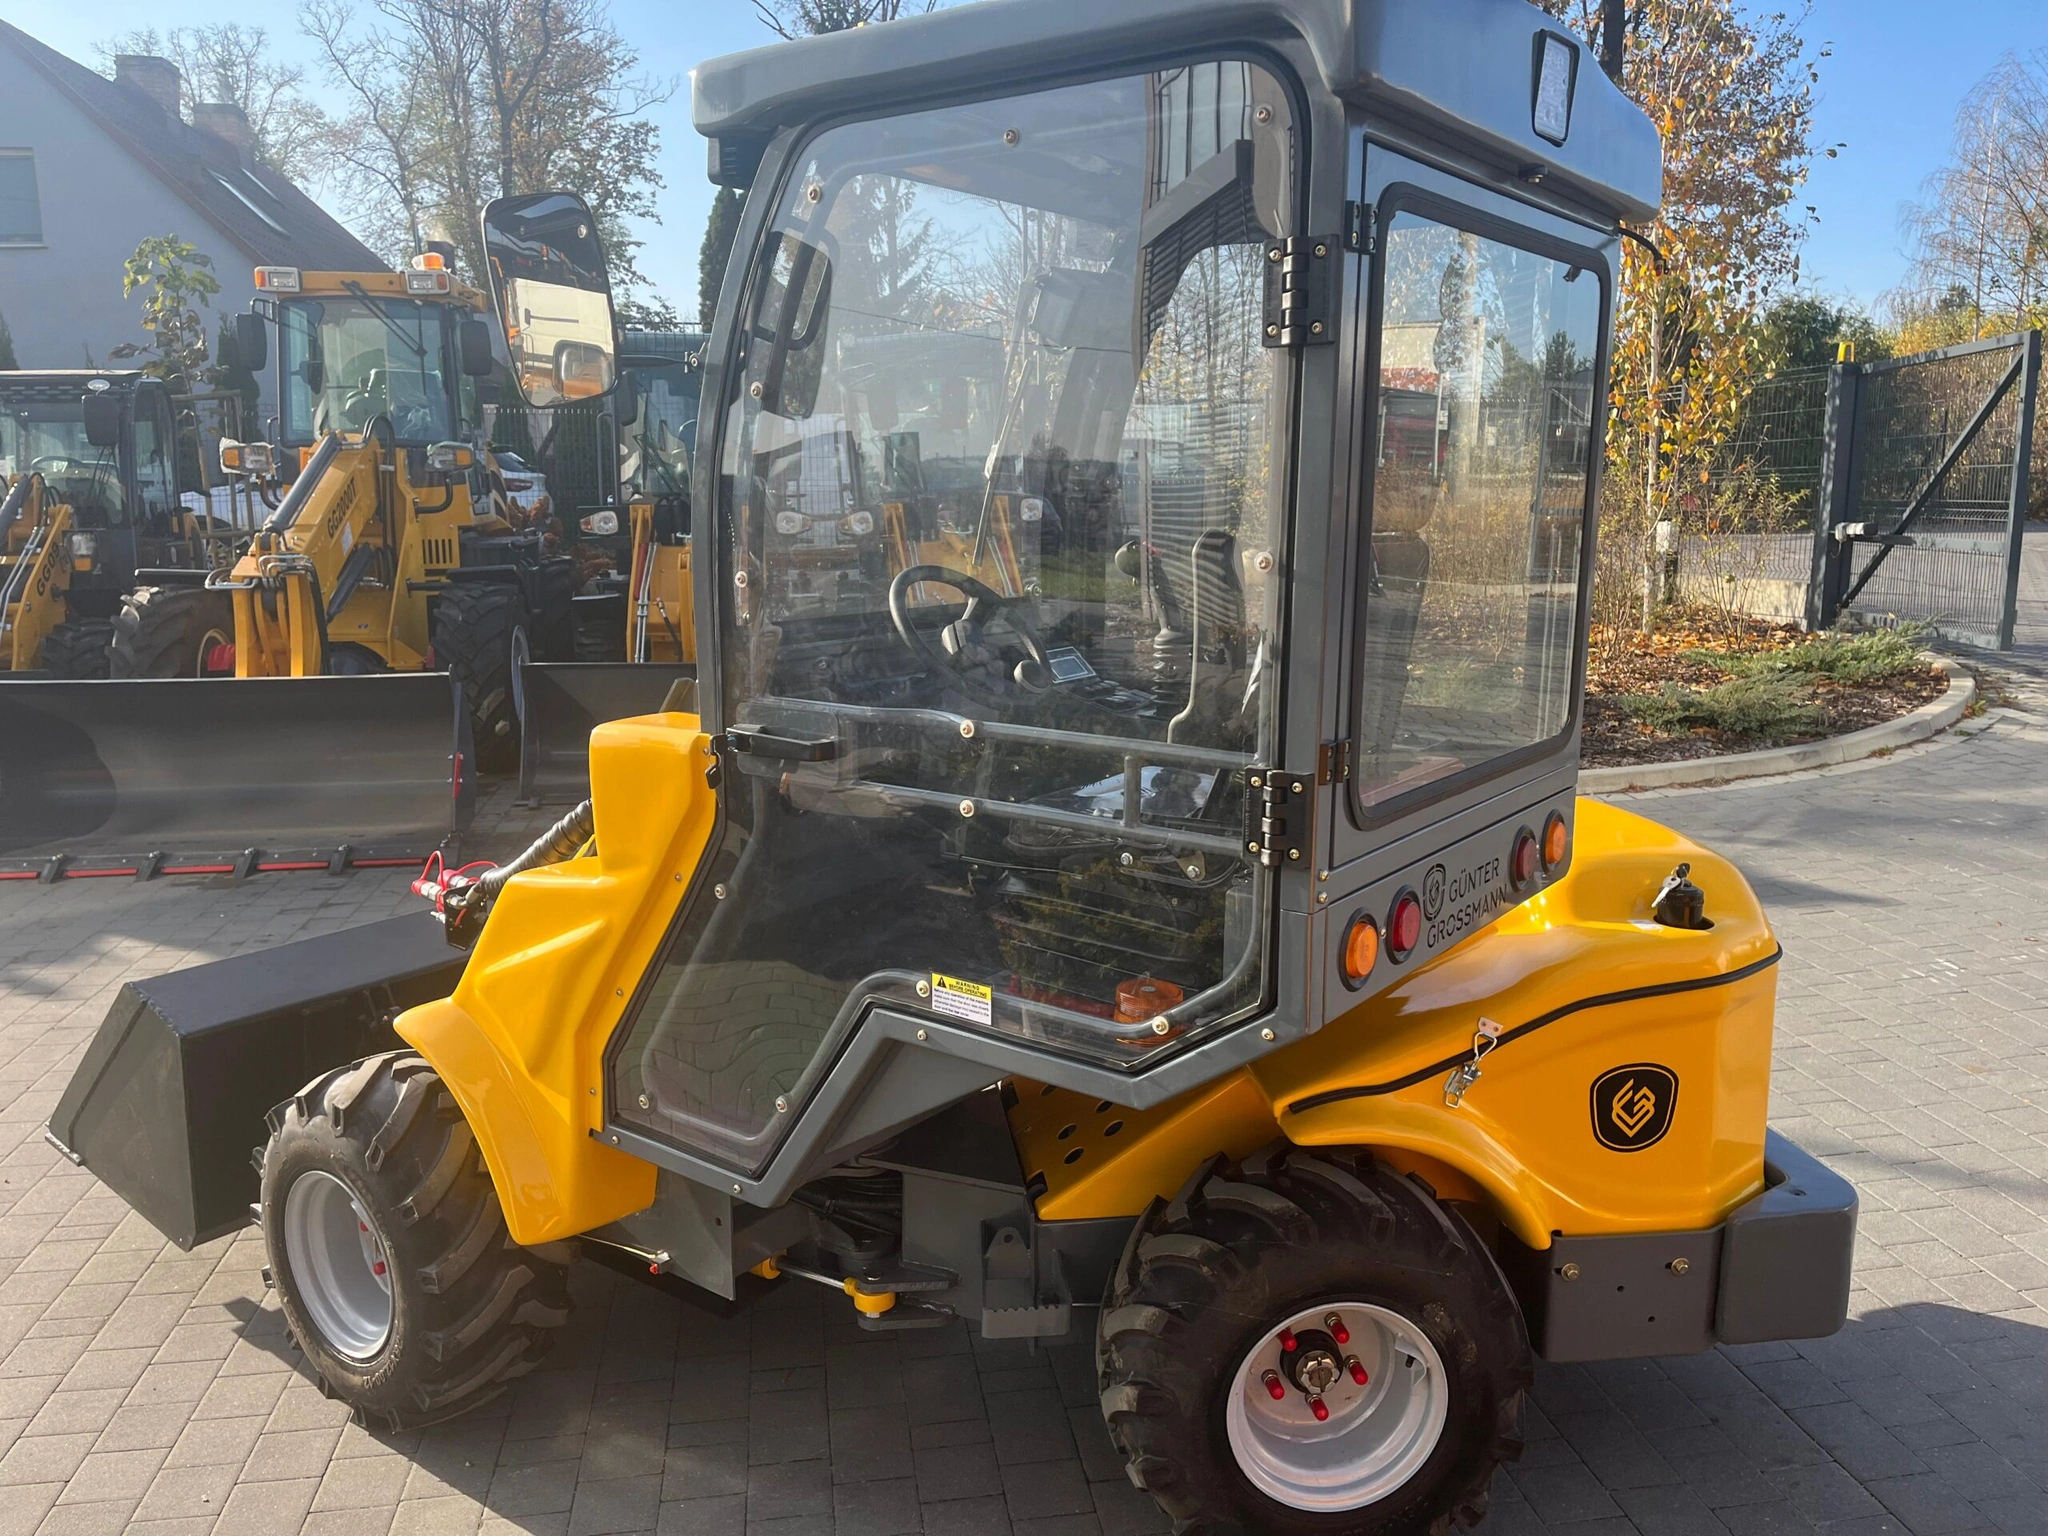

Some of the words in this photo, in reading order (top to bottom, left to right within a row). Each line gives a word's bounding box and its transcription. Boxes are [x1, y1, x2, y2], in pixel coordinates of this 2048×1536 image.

[328, 477, 357, 538] GG2000T
[1449, 857, 1500, 902] GÜNTER
[1427, 883, 1507, 948] GROSSMANN
